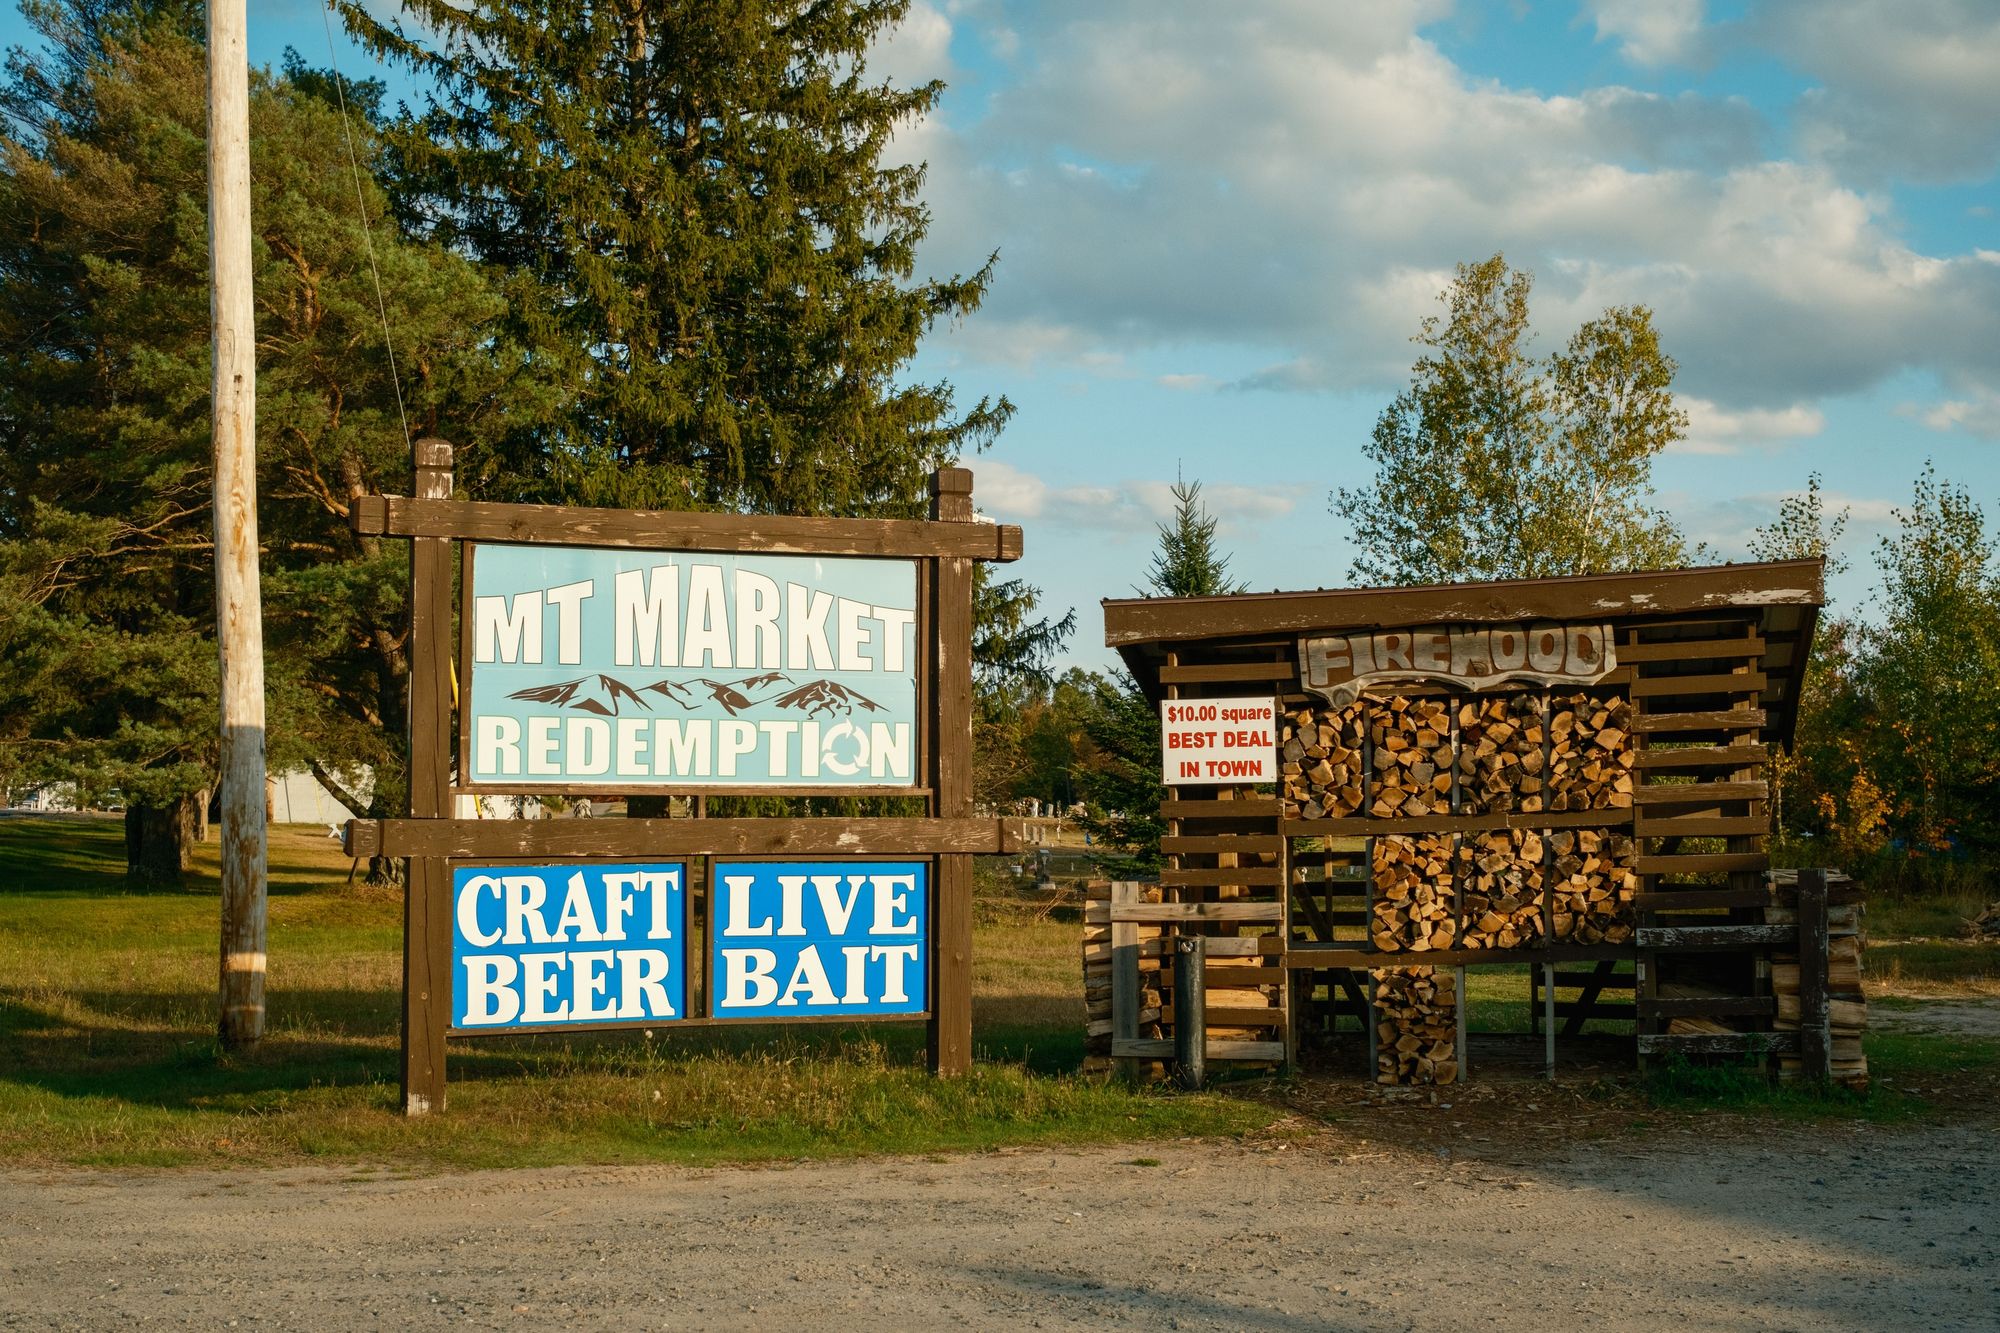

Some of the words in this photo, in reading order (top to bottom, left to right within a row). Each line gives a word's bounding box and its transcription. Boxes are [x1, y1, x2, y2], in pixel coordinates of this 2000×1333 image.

[475, 579, 594, 665] MT
[614, 564, 916, 672] MARKET
[1308, 624, 1604, 686] FIREWOOD
[1168, 706, 1217, 723] $10.00
[1221, 707, 1272, 724] square
[1168, 732, 1217, 749] BEST
[1223, 731, 1273, 748] DEAL
[1180, 761, 1200, 777] IN
[1206, 760, 1262, 777] TOWN
[457, 870, 679, 948] CRAFT
[723, 873, 917, 936] LIVE
[461, 949, 676, 1025] BEER
[721, 943, 918, 1008] BAIT
